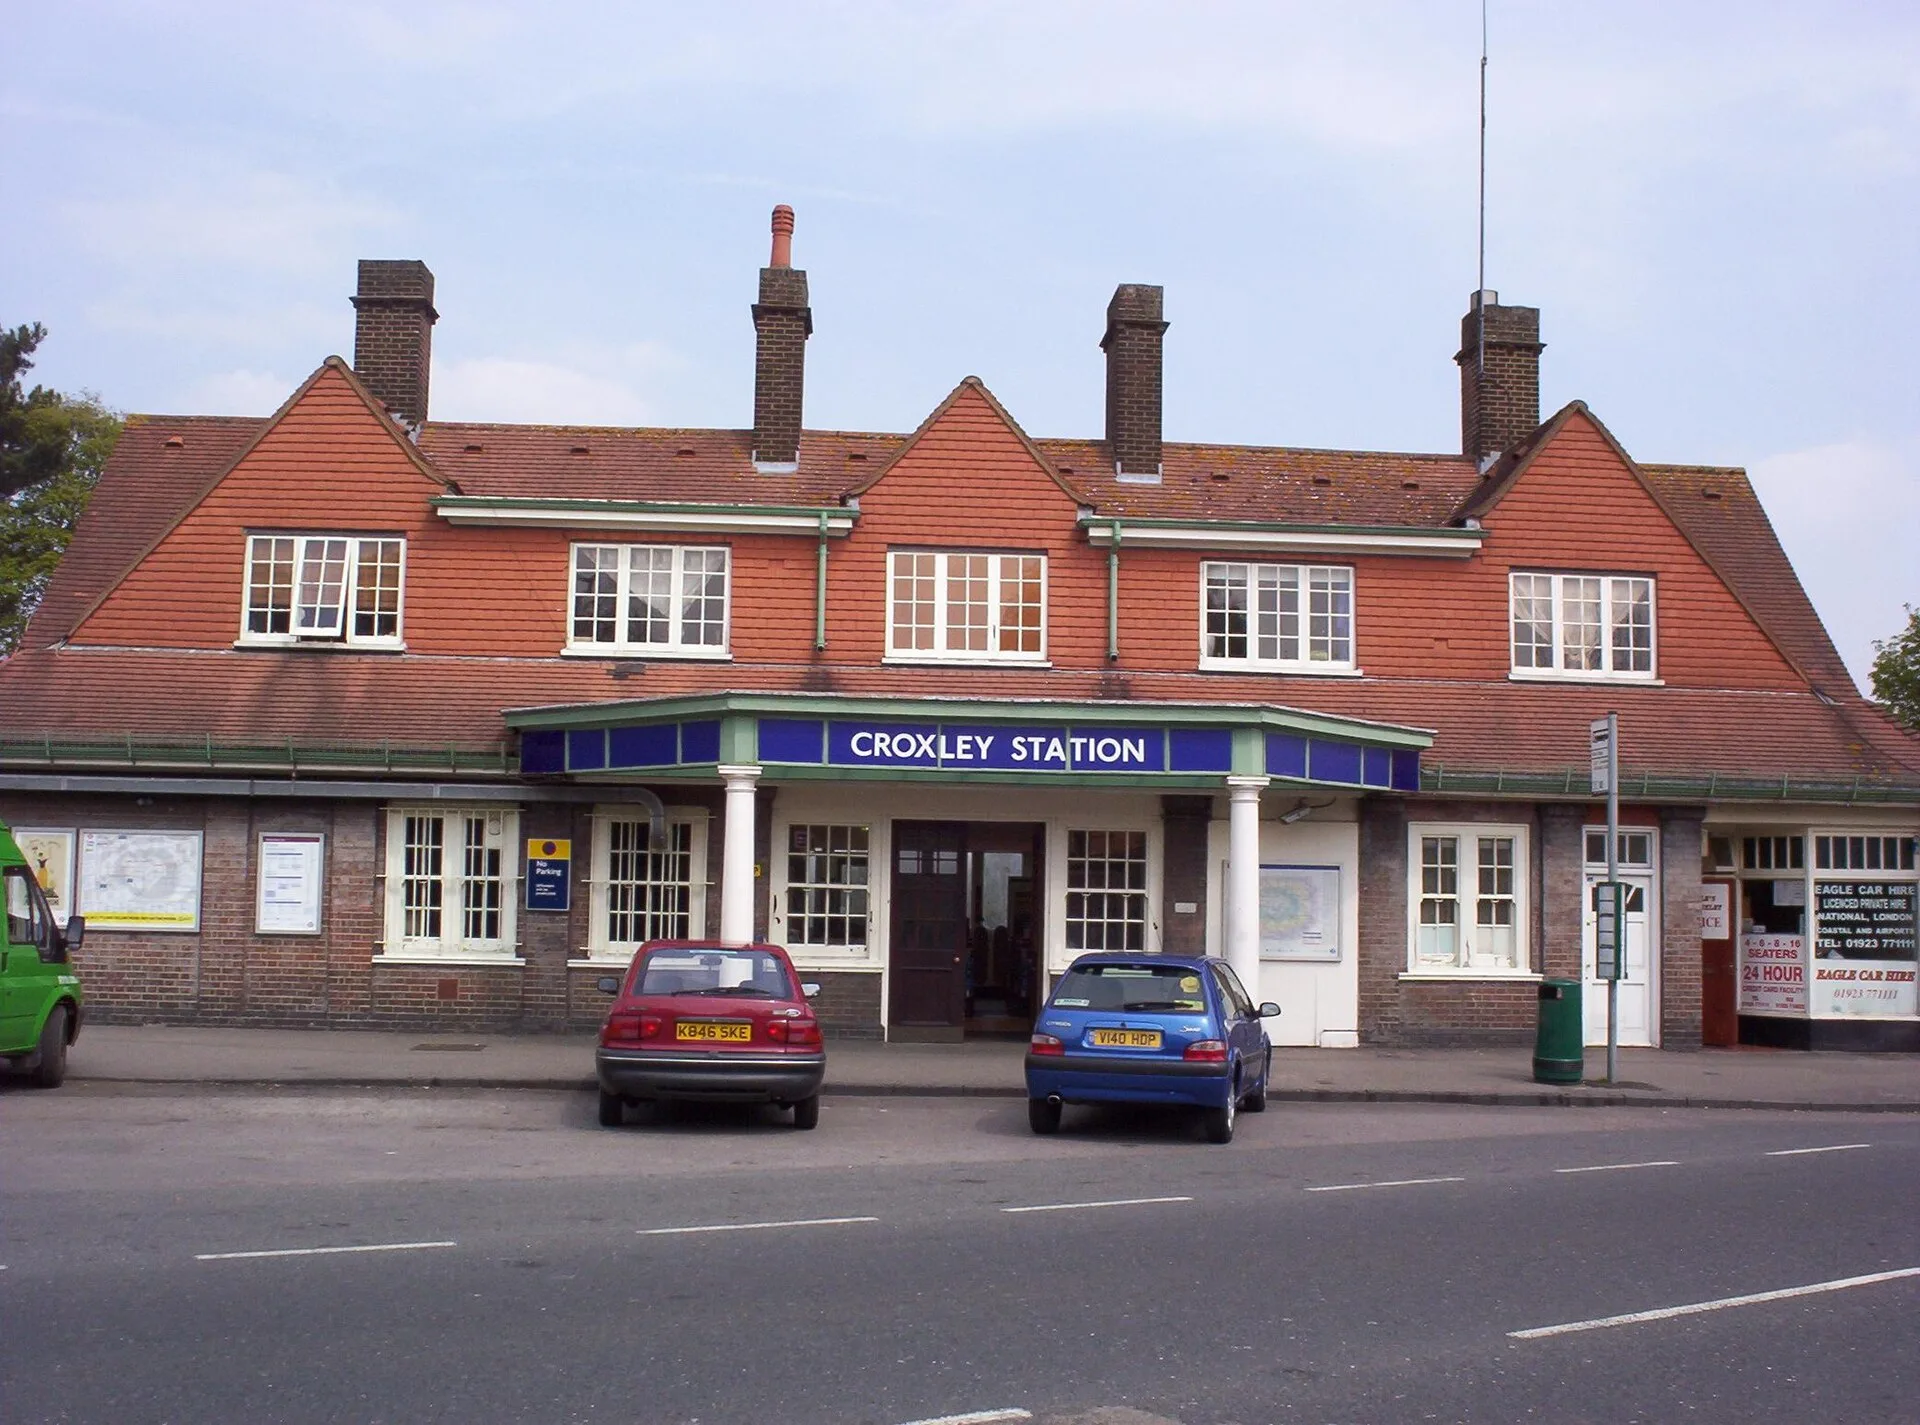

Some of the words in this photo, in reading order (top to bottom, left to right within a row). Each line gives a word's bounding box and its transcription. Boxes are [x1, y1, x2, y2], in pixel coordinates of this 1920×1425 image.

[850, 732, 994, 760] CROXLEY
[1011, 736, 1145, 763] STATION
[536, 868, 562, 876] Parking
[1815, 885, 1853, 895] EAGLE
[1858, 885, 1883, 895] CAR
[1888, 886, 1915, 896] HIRE
[1860, 899, 1889, 909] PRIVATE
[1890, 899, 1907, 909] HIRE
[1817, 912, 1870, 922] NATIONAL,
[1873, 913, 1913, 921] LONDON
[1876, 927, 1915, 935] AIRPORTS
[1818, 939, 1842, 948] TEL:
[1846, 939, 1878, 948] 01923
[1748, 949, 1798, 959] SEATERS
[1743, 965, 1759, 980] 24
[1763, 966, 1803, 981] HOUR
[1816, 969, 1857, 980] EAGLE
[1859, 970, 1884, 981] CAR
[1885, 970, 1916, 982] HIRE
[678, 1024, 716, 1038] K846
[721, 1025, 749, 1039] SKE
[1100, 1030, 1126, 1044] V140
